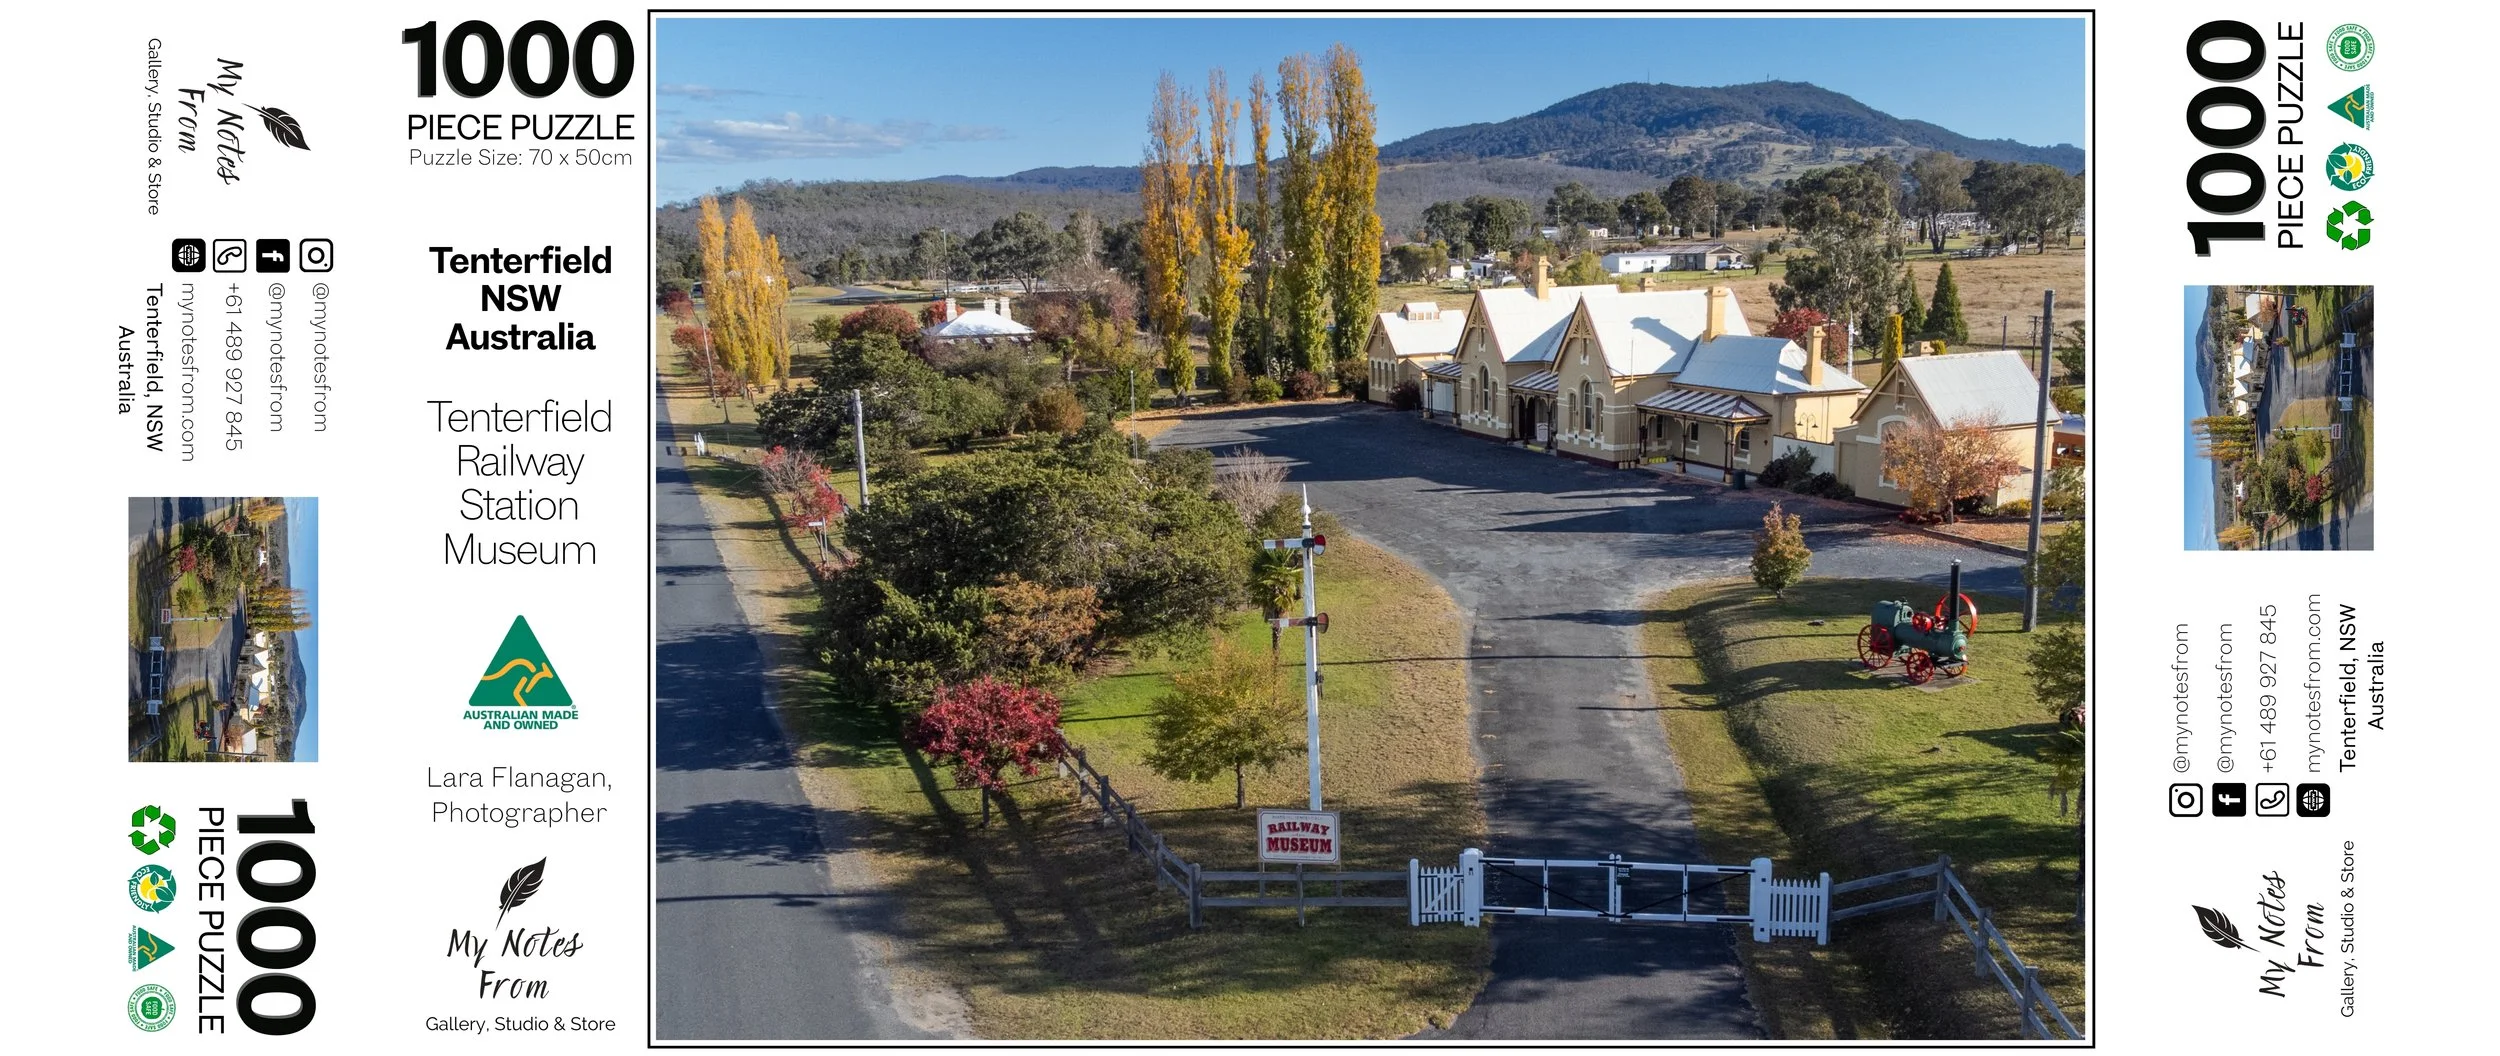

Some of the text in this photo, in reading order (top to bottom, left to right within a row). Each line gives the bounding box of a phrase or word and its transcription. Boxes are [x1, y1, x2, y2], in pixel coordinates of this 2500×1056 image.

[402, 20, 634, 98] 1000
[145, 38, 162, 215] Gallery, Studio & Store
[178, 89, 205, 153] From
[207, 58, 246, 185] My Notes
[409, 114, 634, 140] PIECE PUZZLE
[2186, 19, 2266, 257] 1000
[2278, 21, 2303, 247] PIECE PUZZLE
[410, 148, 632, 165] Puzzle Size: 70 x 50cm
[2353, 146, 2372, 189] ECO FRIENDLY
[429, 245, 611, 274] Tenterfield
[481, 284, 561, 312] NSW
[144, 283, 163, 452] Tenterfield, NSW
[226, 283, 242, 451] +61 489 927 845
[266, 282, 288, 432] @mynotesfrom
[310, 282, 332, 432] @mynotesfrom
[446, 321, 596, 350] Australia
[119, 325, 135, 415] Australia
[178, 283, 199, 462] mynotesfrom.com
[427, 399, 612, 433] Tenterfield
[458, 444, 584, 485] Railway
[460, 488, 578, 521] Station
[445, 533, 596, 565] Museum
[2170, 623, 2192, 773] @mynotesfrom
[2214, 623, 2236, 773] @mynotesfrom
[2260, 604, 2276, 772] +61 489 927 845
[2303, 593, 2324, 772] mynotesfrom.com
[2339, 603, 2358, 772] Tenterfield, NSW
[2367, 640, 2383, 730] Australia
[463, 710, 579, 720] AUSTRALIAN MADE
[483, 720, 559, 730] AND OWNED
[428, 766, 612, 793] Lara Flanagan,
[433, 800, 607, 828] Photographer
[1266, 837, 1332, 853] MUSEUM
[1267, 822, 1330, 835] RAILWAY
[130, 866, 150, 910] ECO FRIENDLY
[236, 798, 316, 1036] 1000
[199, 808, 224, 1034] PIECE PUZZLE
[447, 926, 583, 968] My Notes
[2256, 870, 2295, 997] My Notes
[2297, 902, 2324, 966] From
[2340, 840, 2357, 1017] Gallery, Studio & Store
[480, 970, 549, 999] From
[426, 1017, 616, 1035] Gallery, Studio & Store
